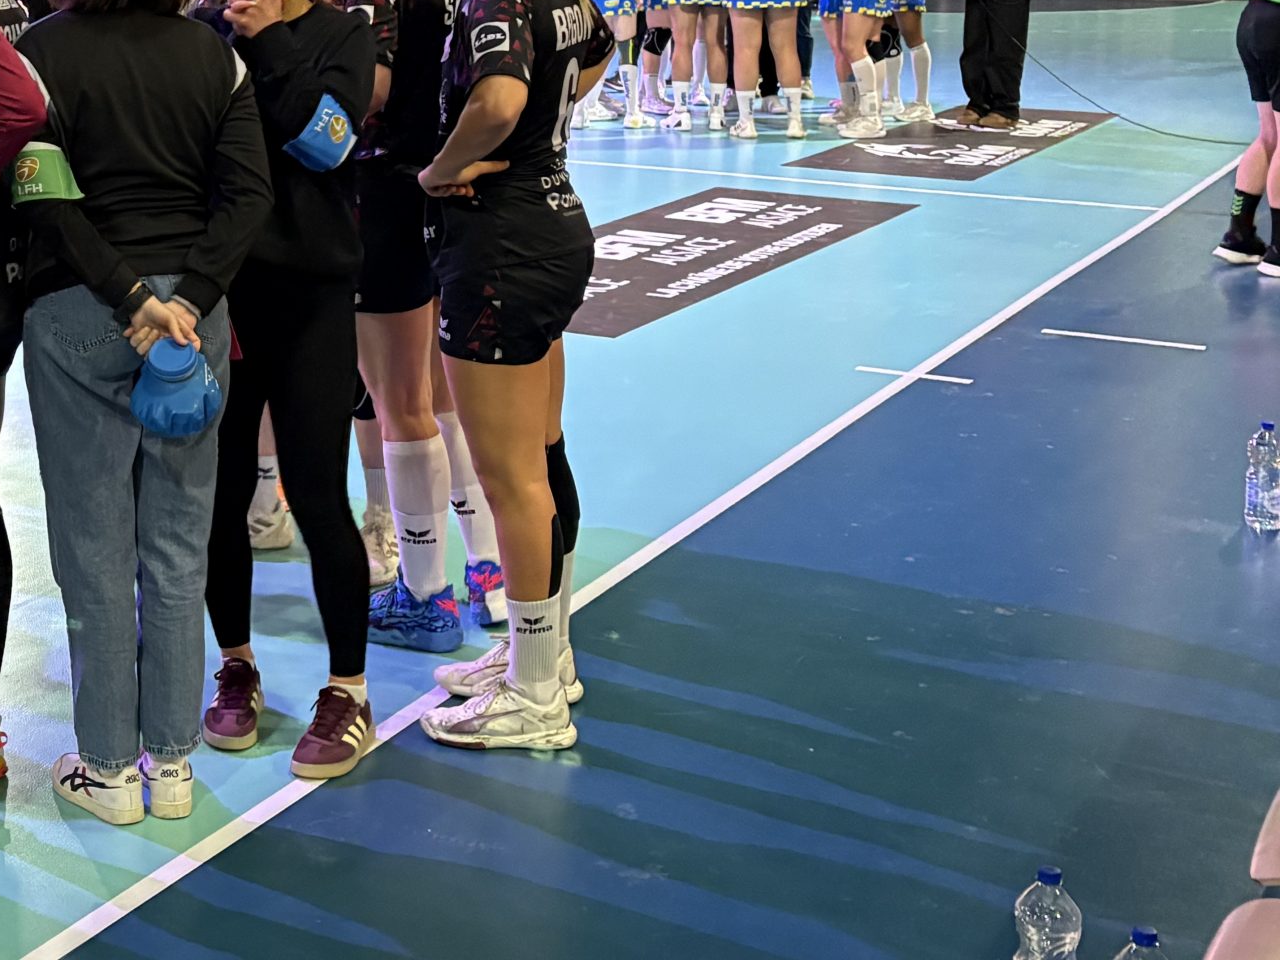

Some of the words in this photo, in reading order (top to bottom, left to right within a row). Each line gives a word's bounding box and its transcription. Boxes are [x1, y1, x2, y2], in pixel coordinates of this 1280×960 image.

[315, 108, 333, 133] LFH
[18, 183, 43, 195] LFH
[664, 197, 776, 224] BFM
[741, 203, 822, 229] ALSACE
[594, 229, 687, 261] BFM
[642, 237, 736, 266] ALSACE
[401, 535, 437, 545] erima
[516, 624, 553, 635] erima
